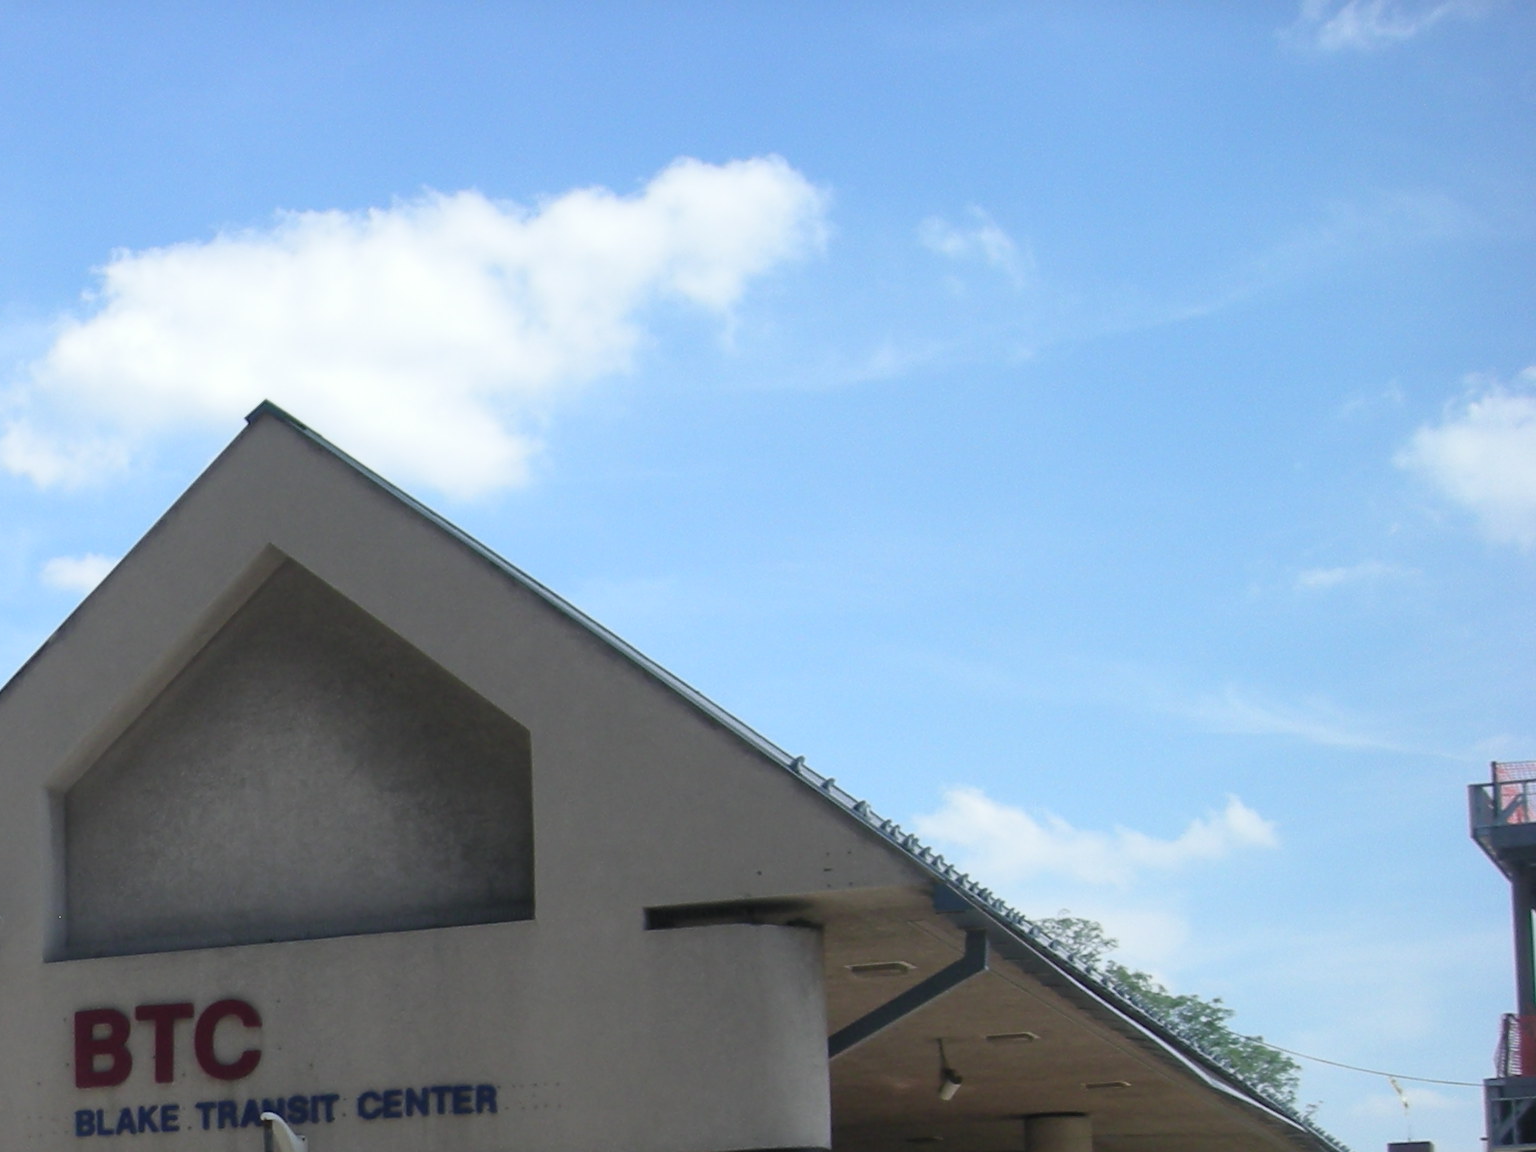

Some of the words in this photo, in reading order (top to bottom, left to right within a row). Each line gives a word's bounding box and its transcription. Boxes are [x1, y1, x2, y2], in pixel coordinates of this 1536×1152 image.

[74, 999, 262, 1089] BTC
[75, 1104, 180, 1137] BLAKE
[196, 1094, 340, 1131] TRANSIT
[357, 1084, 498, 1121] CENTER
